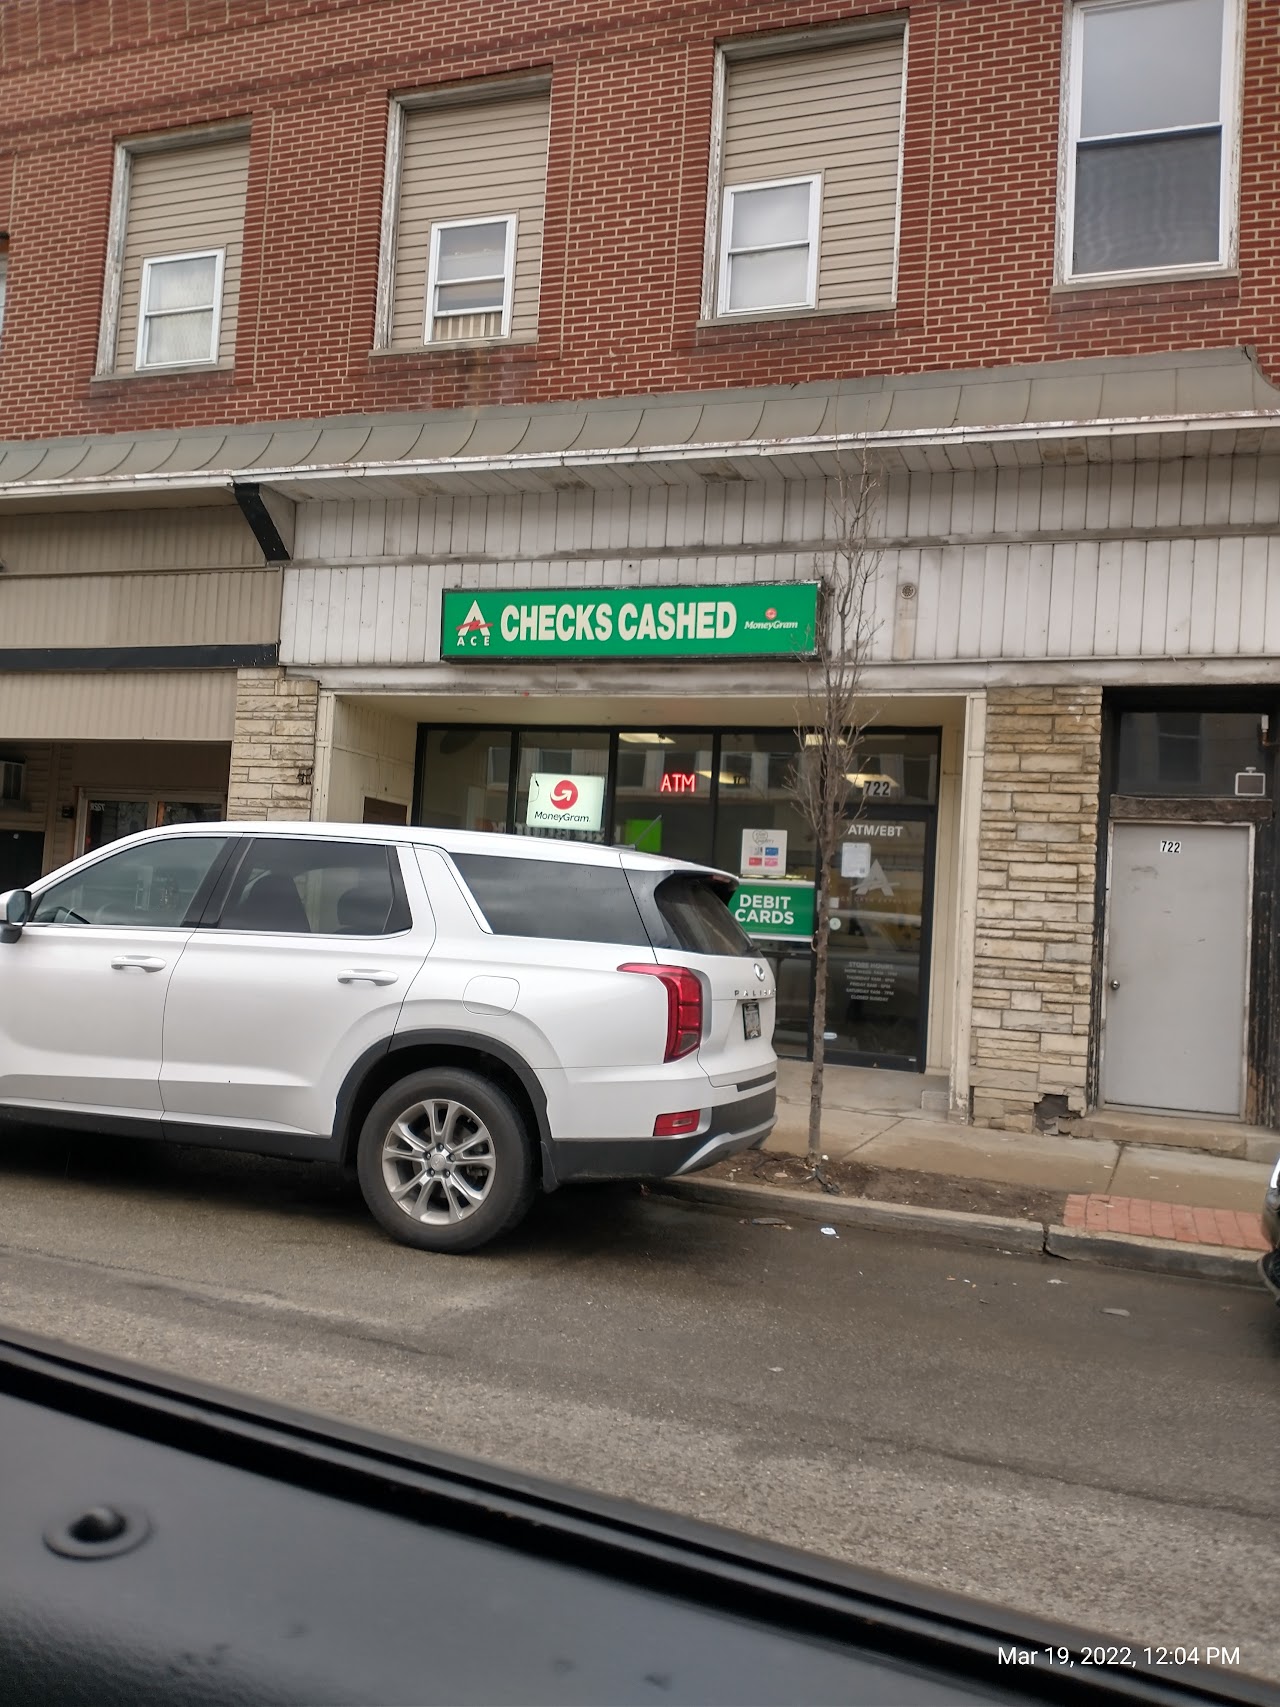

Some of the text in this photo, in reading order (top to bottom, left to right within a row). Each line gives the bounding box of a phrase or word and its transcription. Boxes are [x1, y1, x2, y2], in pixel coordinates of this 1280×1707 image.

[500, 602, 737, 642] CHECKS CASHED
[744, 620, 798, 630] MoneyGram
[457, 636, 490, 646] ACE
[660, 773, 696, 792] ATM
[864, 781, 890, 796] 722
[534, 811, 591, 823] MoneyGram
[848, 824, 903, 837] ATM/EBT
[1161, 840, 1181, 853] 722
[739, 894, 792, 910] DEBIT
[734, 908, 795, 925] CARDS
